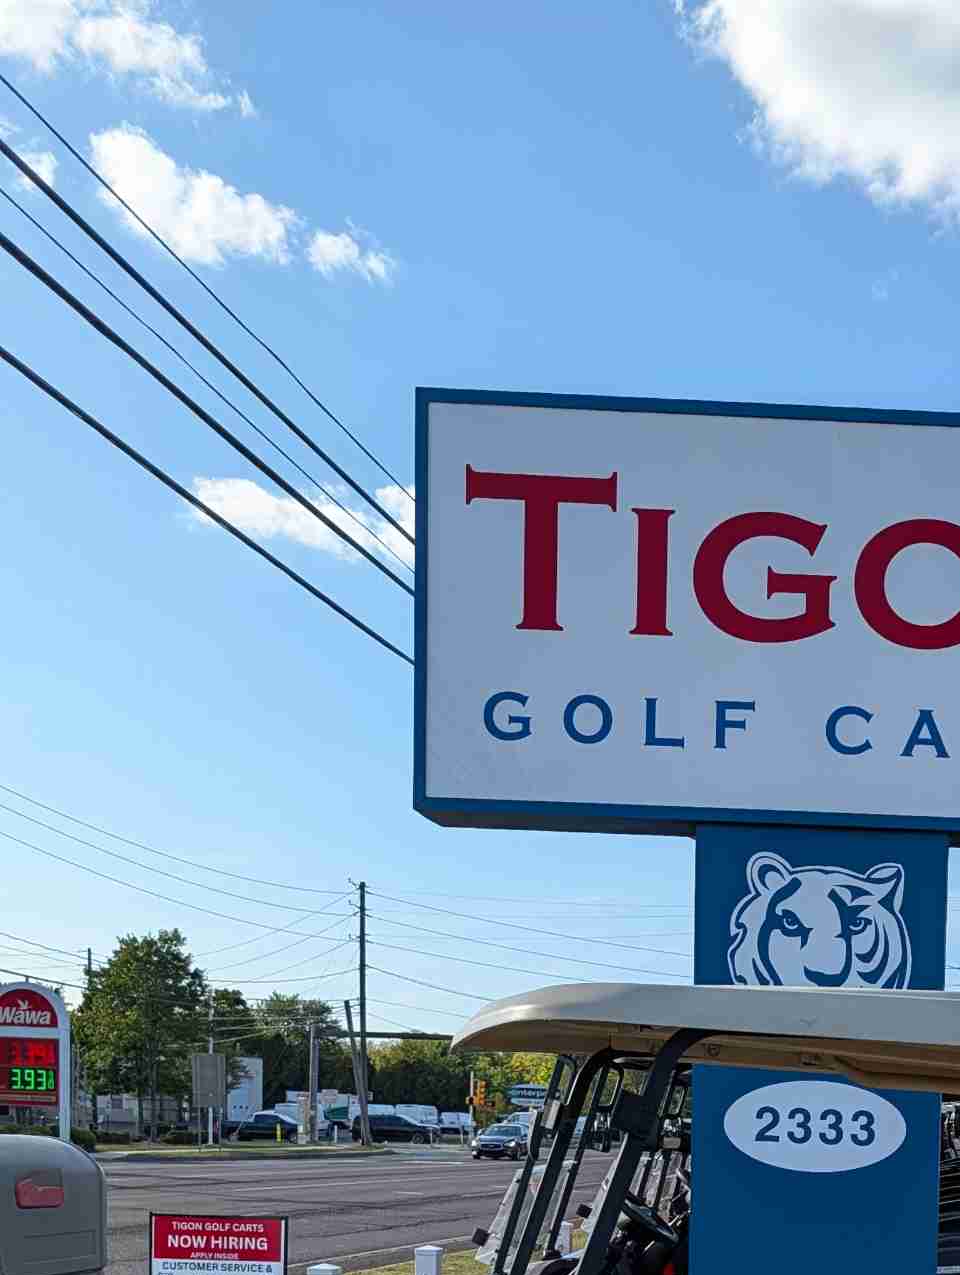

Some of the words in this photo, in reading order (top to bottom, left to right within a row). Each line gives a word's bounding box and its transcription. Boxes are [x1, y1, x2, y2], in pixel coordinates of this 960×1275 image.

[483, 690, 756, 750] GOLF
[754, 1105, 876, 1147] 2333
[172, 1221, 202, 1231] TIGON
[204, 1222, 230, 1232] GOLF
[232, 1223, 264, 1232] CARTS
[167, 1234, 207, 1249] NOW
[211, 1235, 268, 1251] HIRING
[190, 1251, 213, 1259] APPLY
[214, 1252, 239, 1260] INSIDE
[162, 1261, 218, 1272] CUSTOMER
[219, 1262, 264, 1273] SERVICE
[265, 1263, 272, 1273] &
